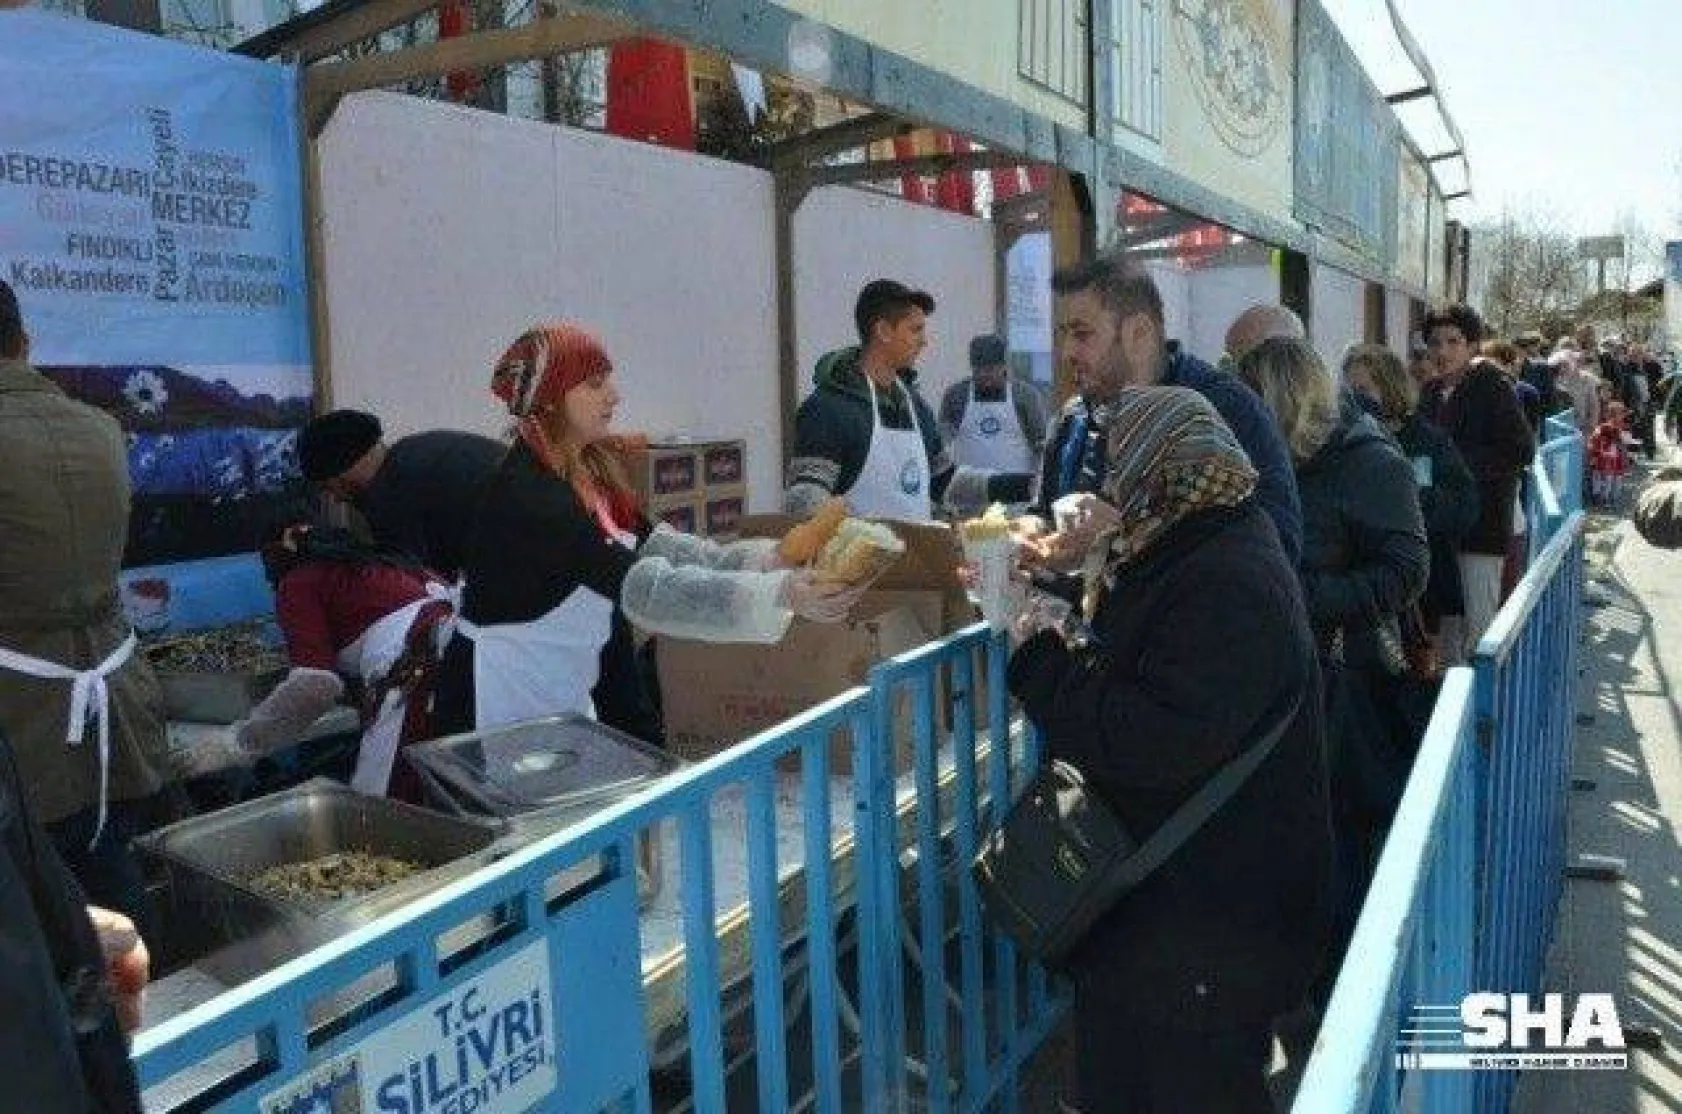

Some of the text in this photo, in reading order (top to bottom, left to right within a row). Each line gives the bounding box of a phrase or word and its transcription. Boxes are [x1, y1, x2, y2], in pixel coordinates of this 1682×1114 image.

[0, 153, 151, 198] EREPAZARI
[152, 192, 251, 229] MERKEZ
[67, 233, 153, 261] FINDIKLI
[154, 225, 178, 302] Pazar
[433, 987, 486, 1037] T.C.
